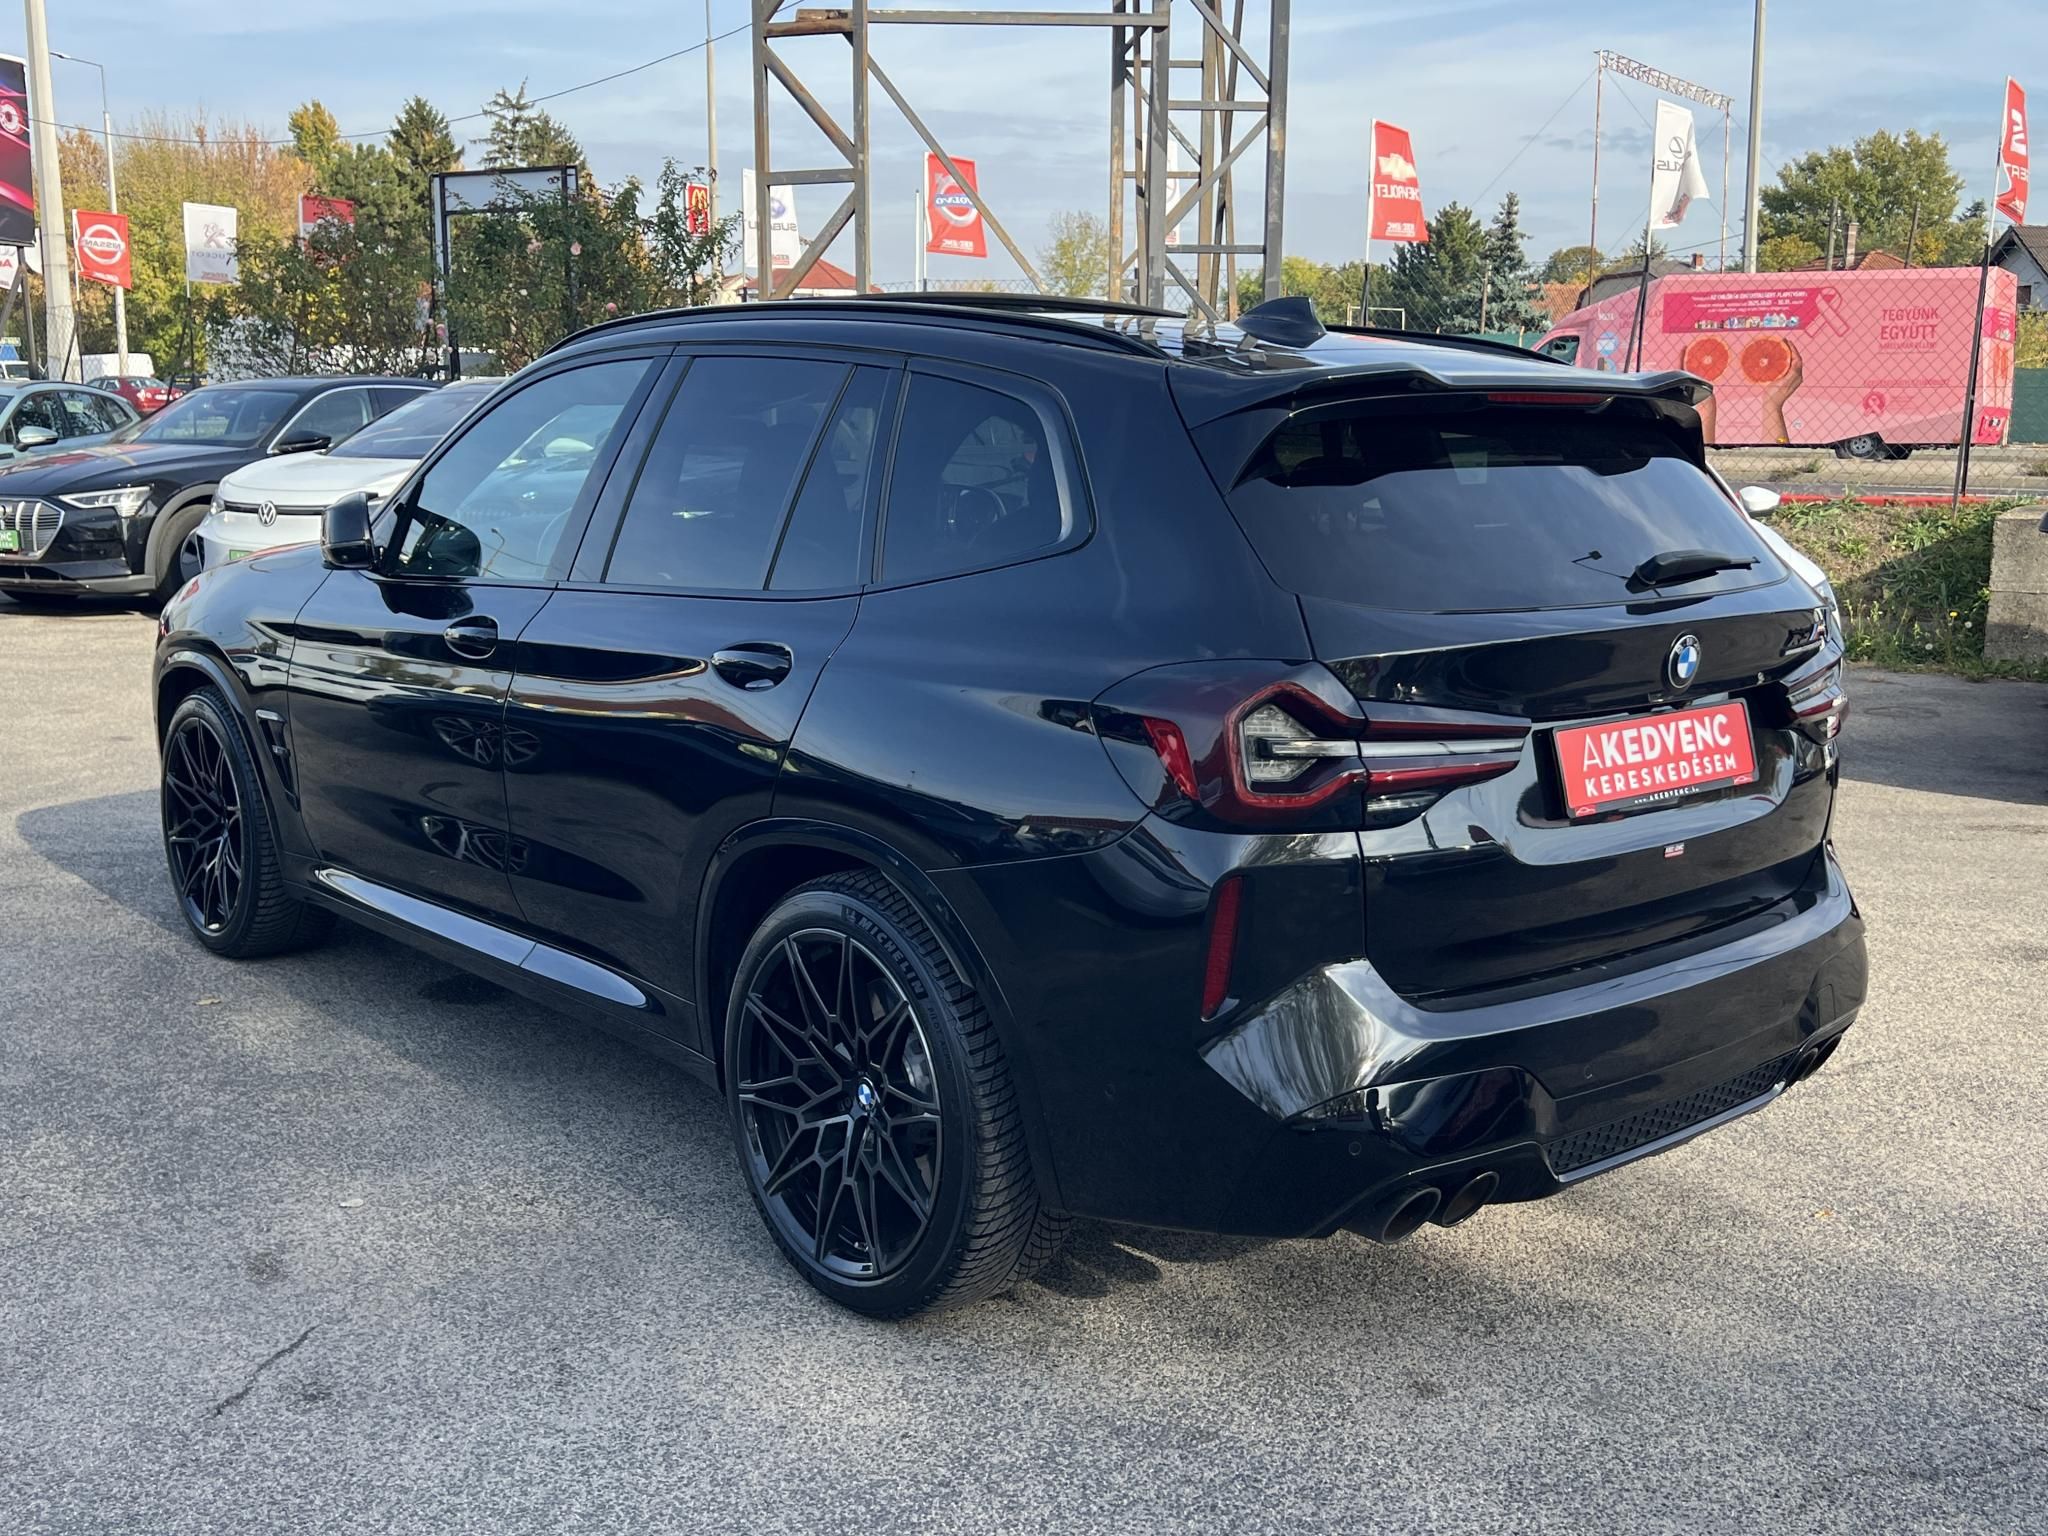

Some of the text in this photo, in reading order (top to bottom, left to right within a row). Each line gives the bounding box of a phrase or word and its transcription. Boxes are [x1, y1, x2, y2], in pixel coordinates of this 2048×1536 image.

[1880, 322, 1937, 340] EGYÜTT
[1584, 752, 1737, 798] KERESKEDÉSEM
[857, 913, 926, 996] MICHELIN
